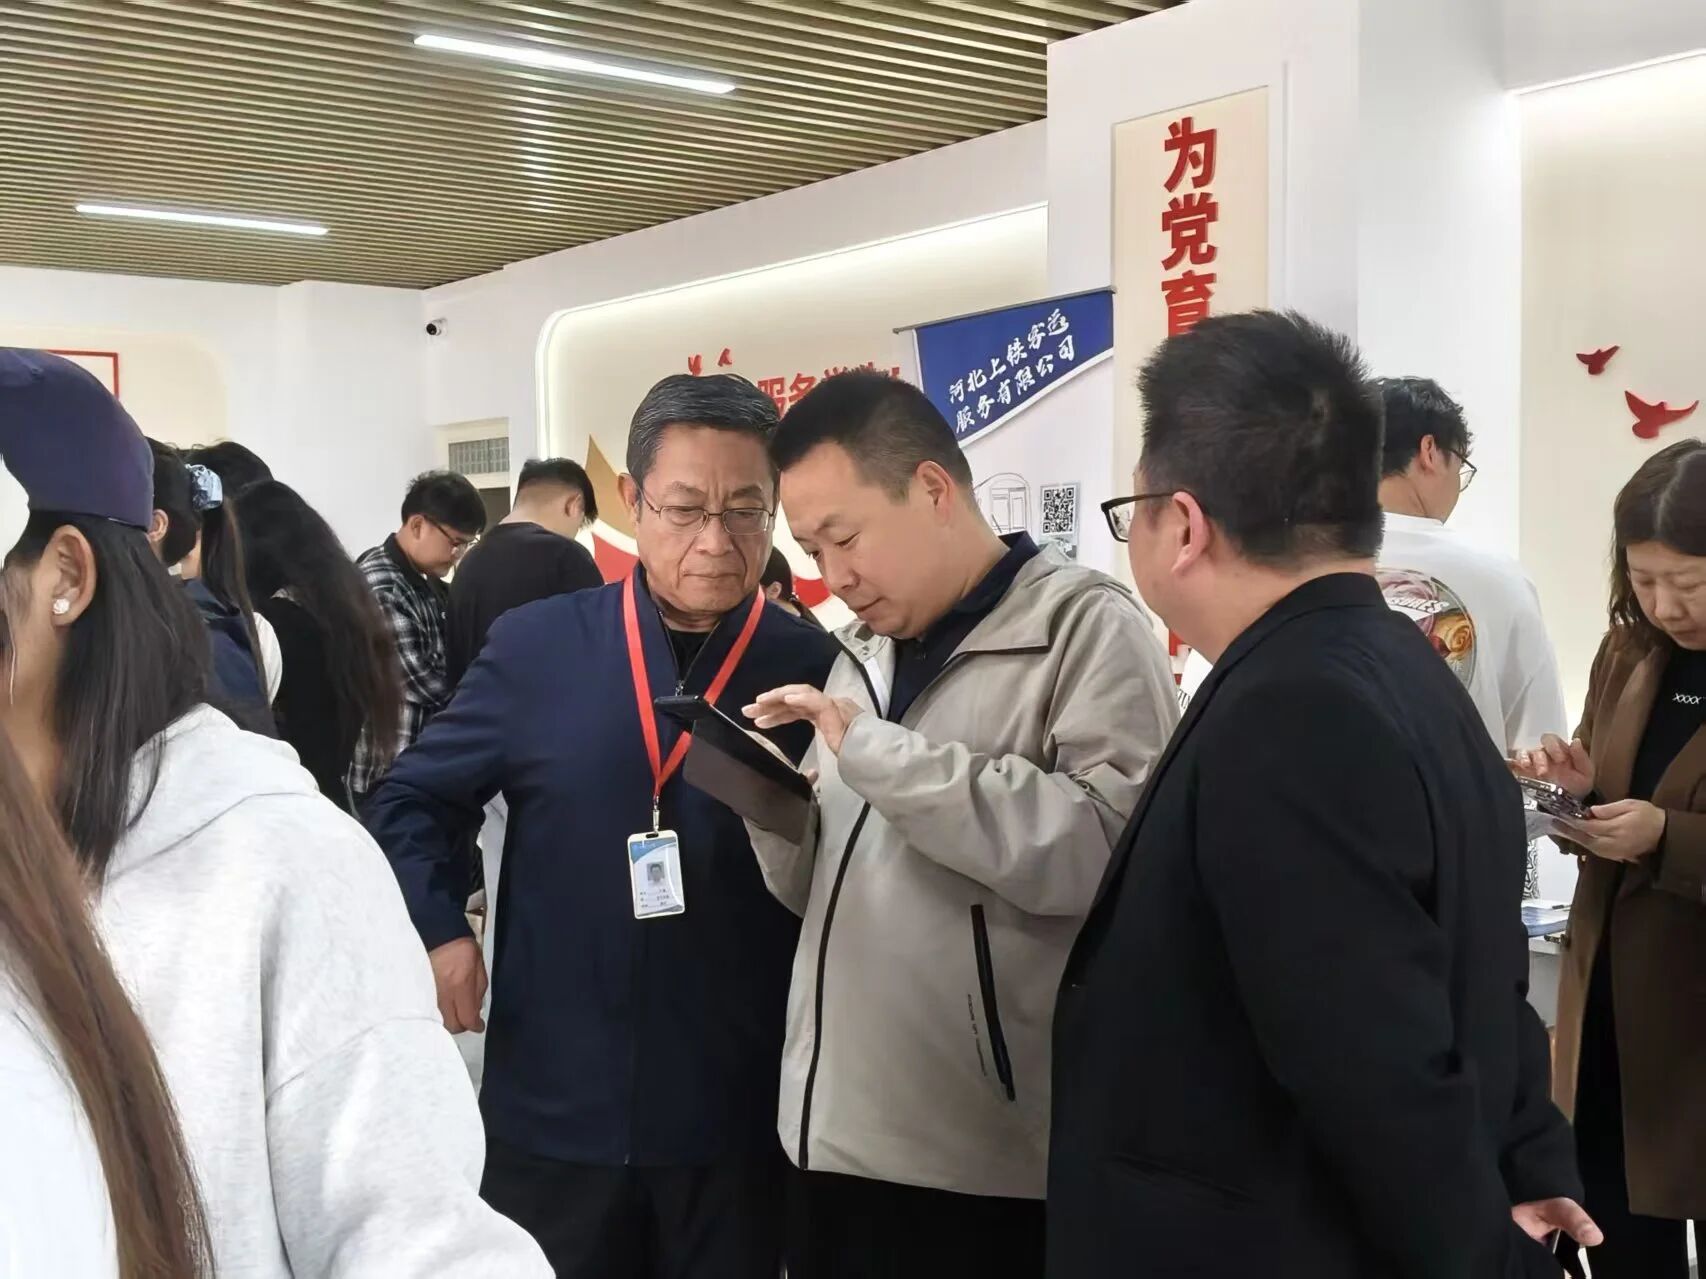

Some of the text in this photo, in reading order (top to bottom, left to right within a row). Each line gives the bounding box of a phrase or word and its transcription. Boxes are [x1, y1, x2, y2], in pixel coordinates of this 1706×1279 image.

[949, 308, 1070, 404] 河北上铁客运
[955, 335, 1076, 434] 服务有限公司
